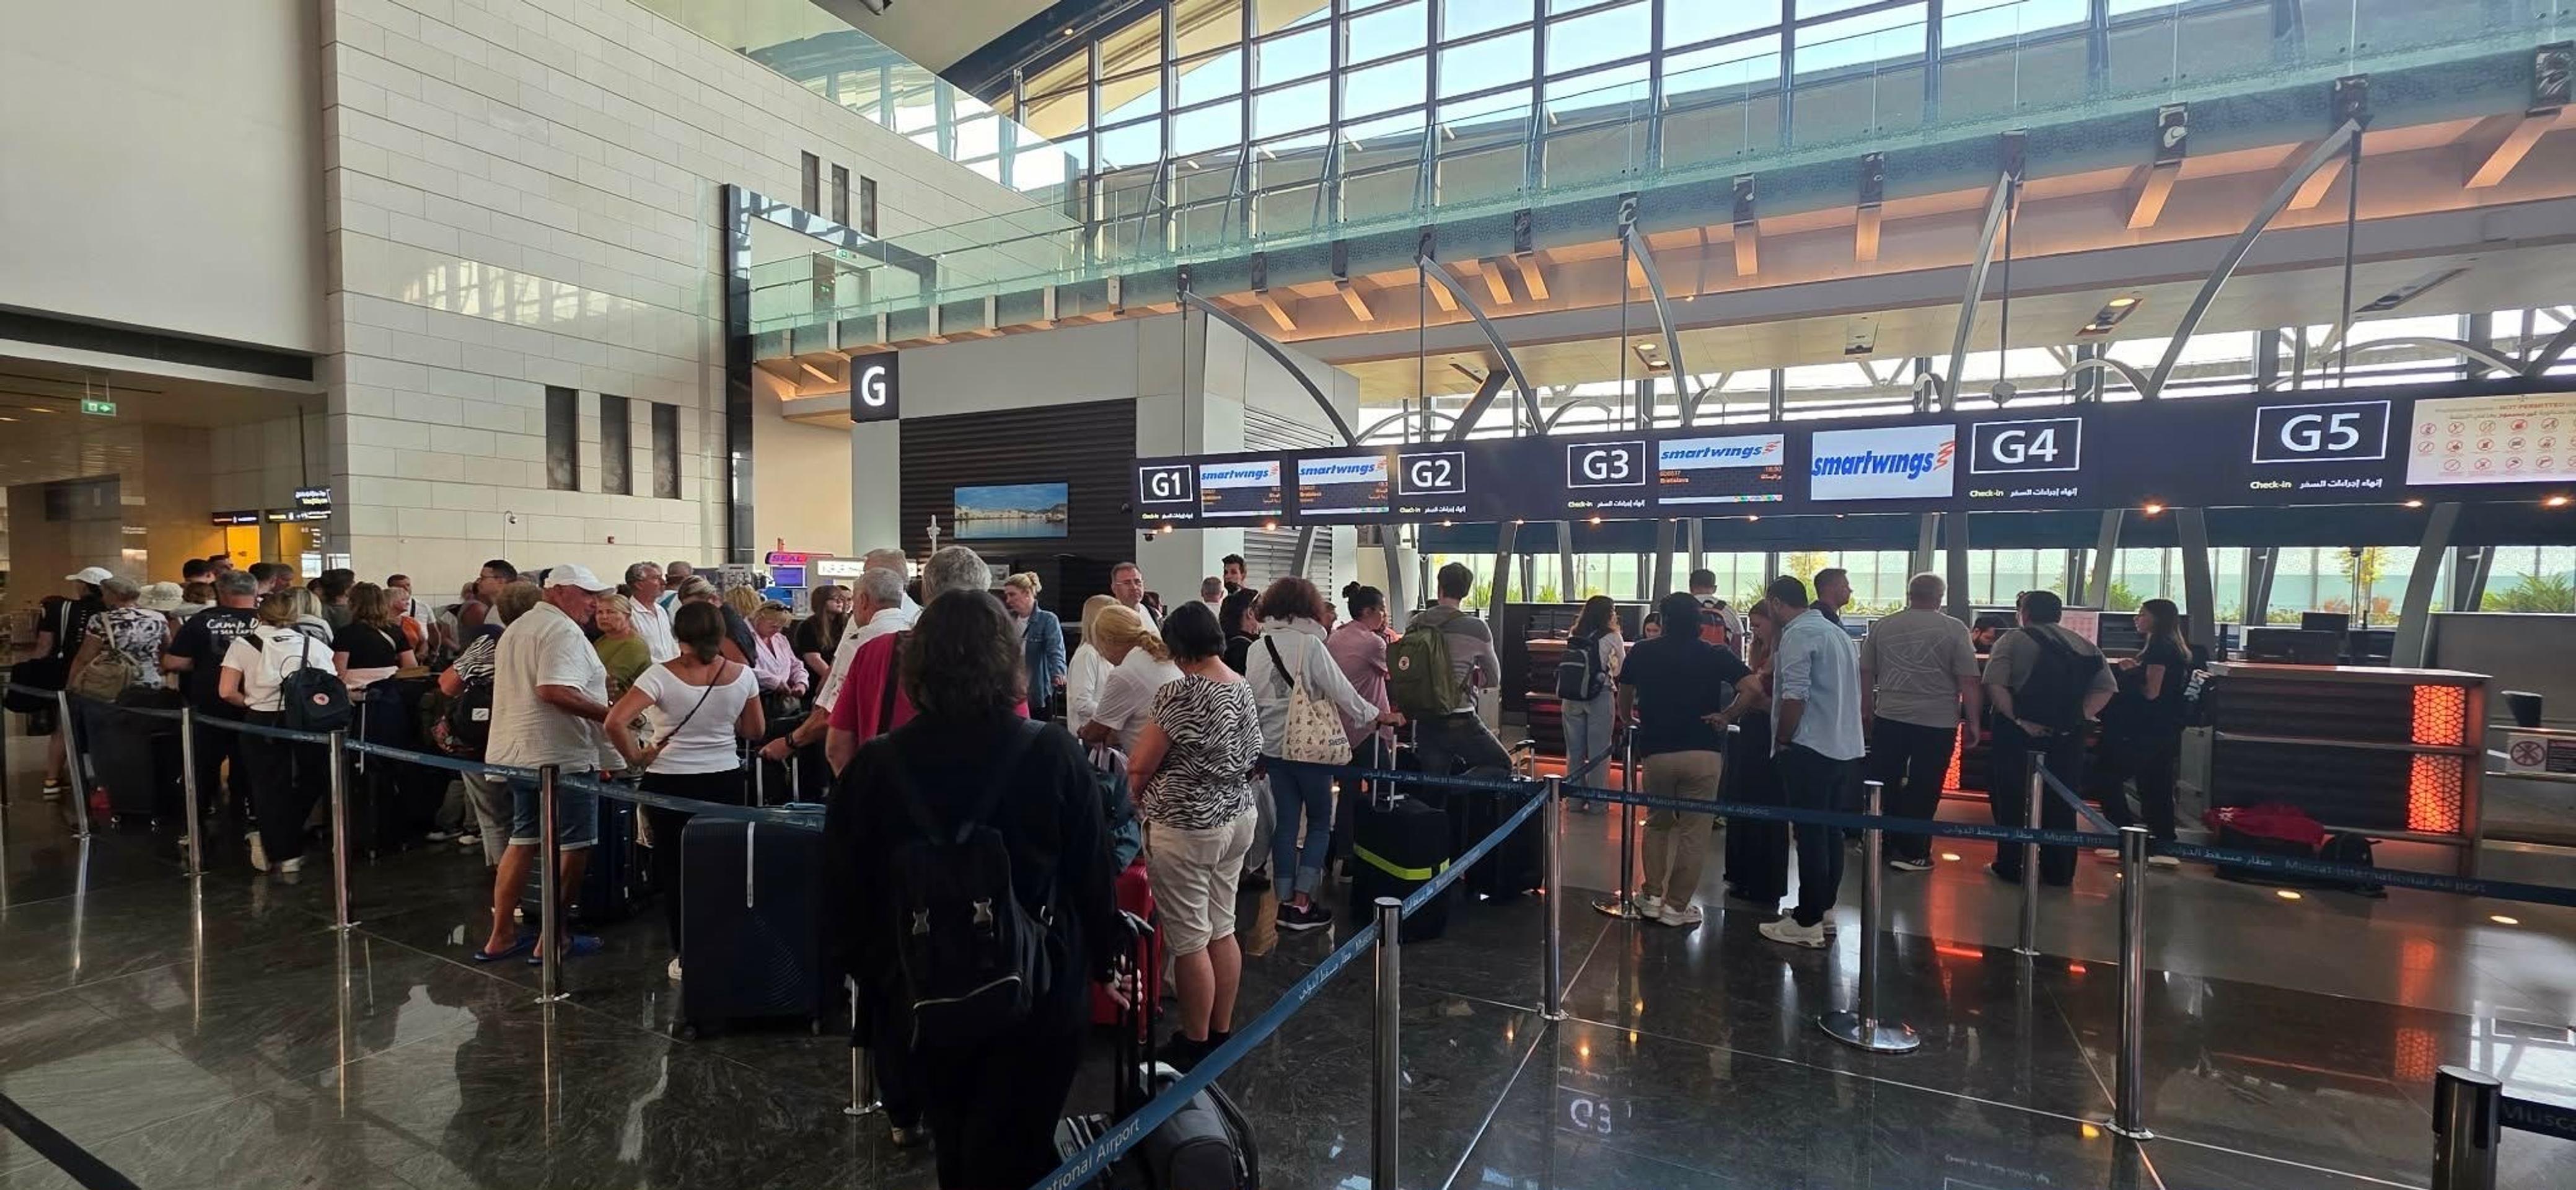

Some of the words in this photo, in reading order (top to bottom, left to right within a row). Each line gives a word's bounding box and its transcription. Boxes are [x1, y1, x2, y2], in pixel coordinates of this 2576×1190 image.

[861, 366, 887, 407] G
[1992, 428, 2059, 464] G4
[2280, 412, 2360, 452] G5
[1583, 449, 1629, 480] G3
[1660, 445, 1764, 459] smartwings
[1811, 450, 1935, 480] smartwings
[1151, 472, 1180, 496] G1
[1201, 469, 1268, 480] smartwings
[1299, 464, 1375, 476] smartwings
[1411, 459, 1451, 488] G2
[2250, 480, 2292, 489] Check-in
[1096, 1117, 1140, 1163] Airport
